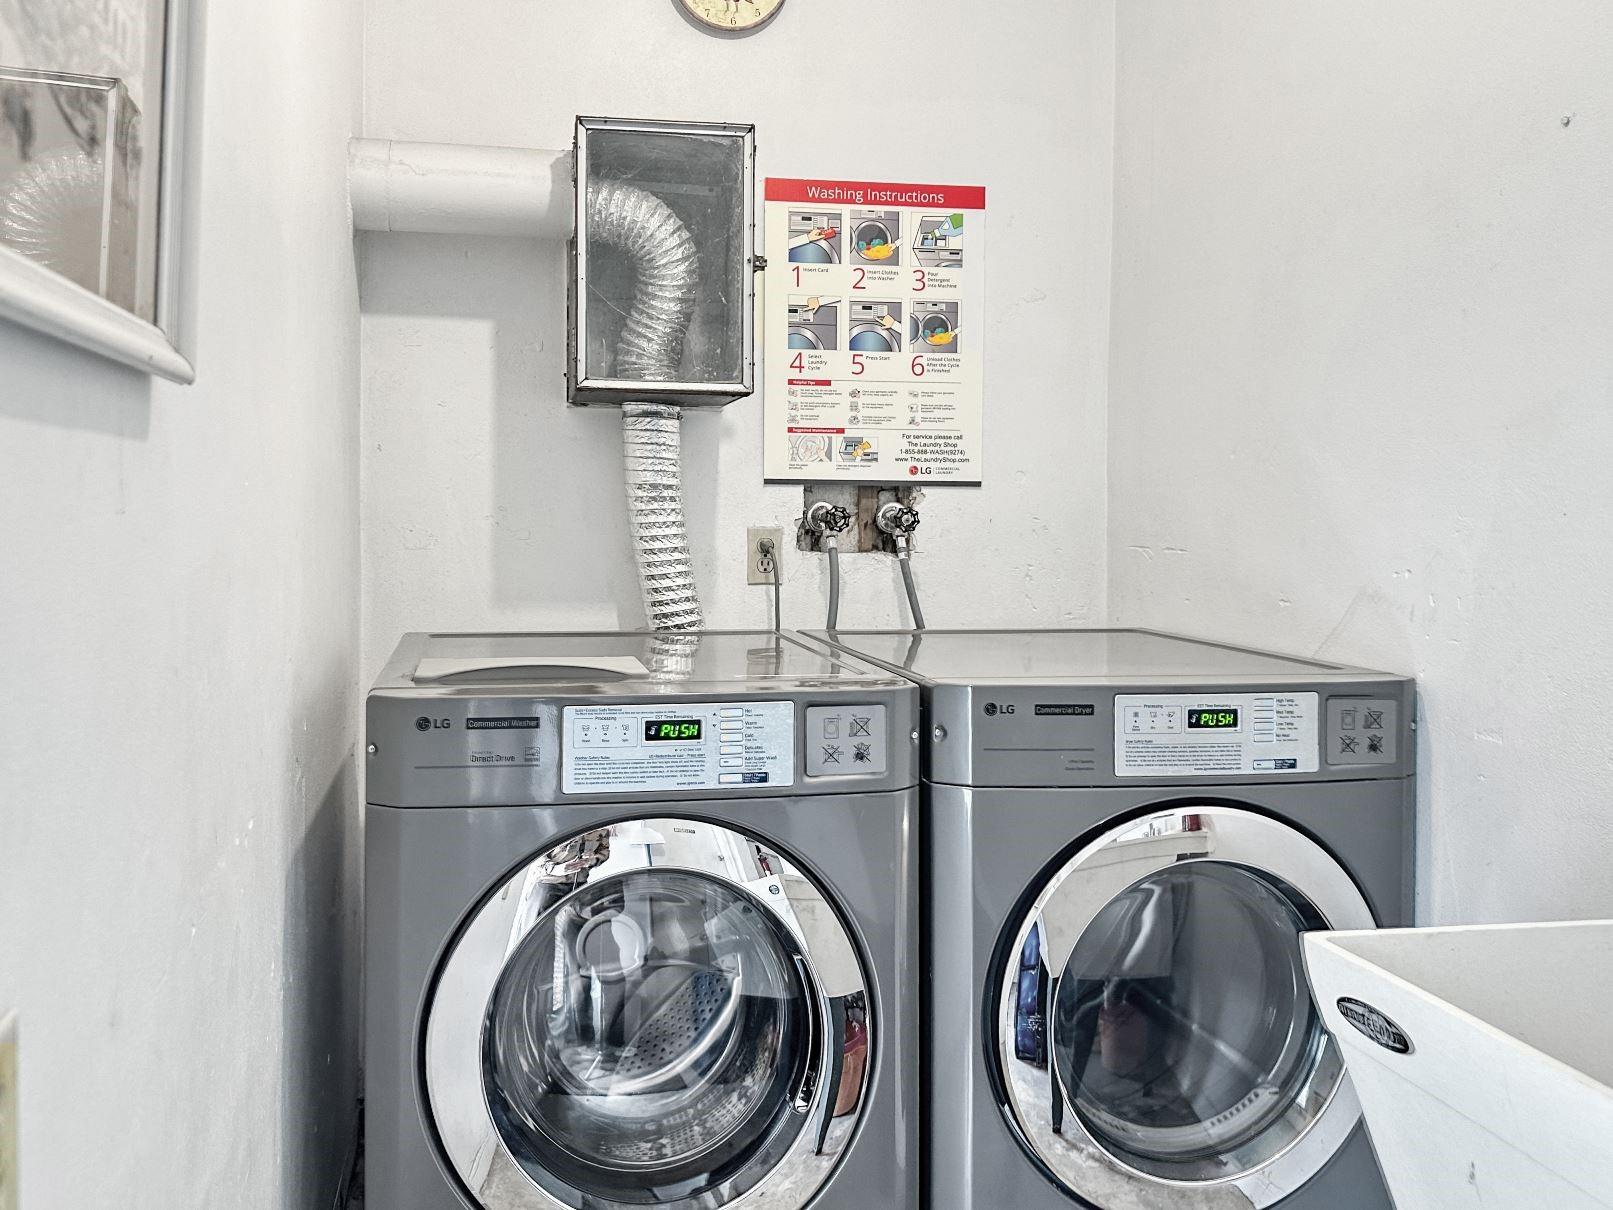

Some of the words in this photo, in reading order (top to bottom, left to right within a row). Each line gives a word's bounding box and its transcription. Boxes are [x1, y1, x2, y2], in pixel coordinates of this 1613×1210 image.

[704, 9, 711, 18] 7
[754, 9, 761, 17] 5
[730, 17, 737, 25] 6
[807, 186, 863, 203] Washing
[867, 188, 944, 204] Instructions
[792, 266, 800, 287] 1
[853, 267, 866, 289] 2
[912, 269, 926, 291] 3
[789, 352, 805, 373] 4
[851, 353, 865, 374] 5
[911, 355, 925, 376] 6
[919, 441, 942, 449] Laundry
[900, 449, 966, 457] 1-855-888-WASH(9274)
[920, 467, 932, 475] LG
[999, 704, 1015, 715] LG
[1036, 706, 1073, 714] Commercial
[1075, 706, 1093, 715] Dryer
[434, 718, 451, 729] LG
[468, 719, 510, 728] Commercial
[511, 718, 538, 728] Washer
[1200, 713, 1234, 726] PUSH
[659, 723, 699, 738] PUSH
[471, 755, 494, 763] Direct
[495, 754, 516, 762] Drive
